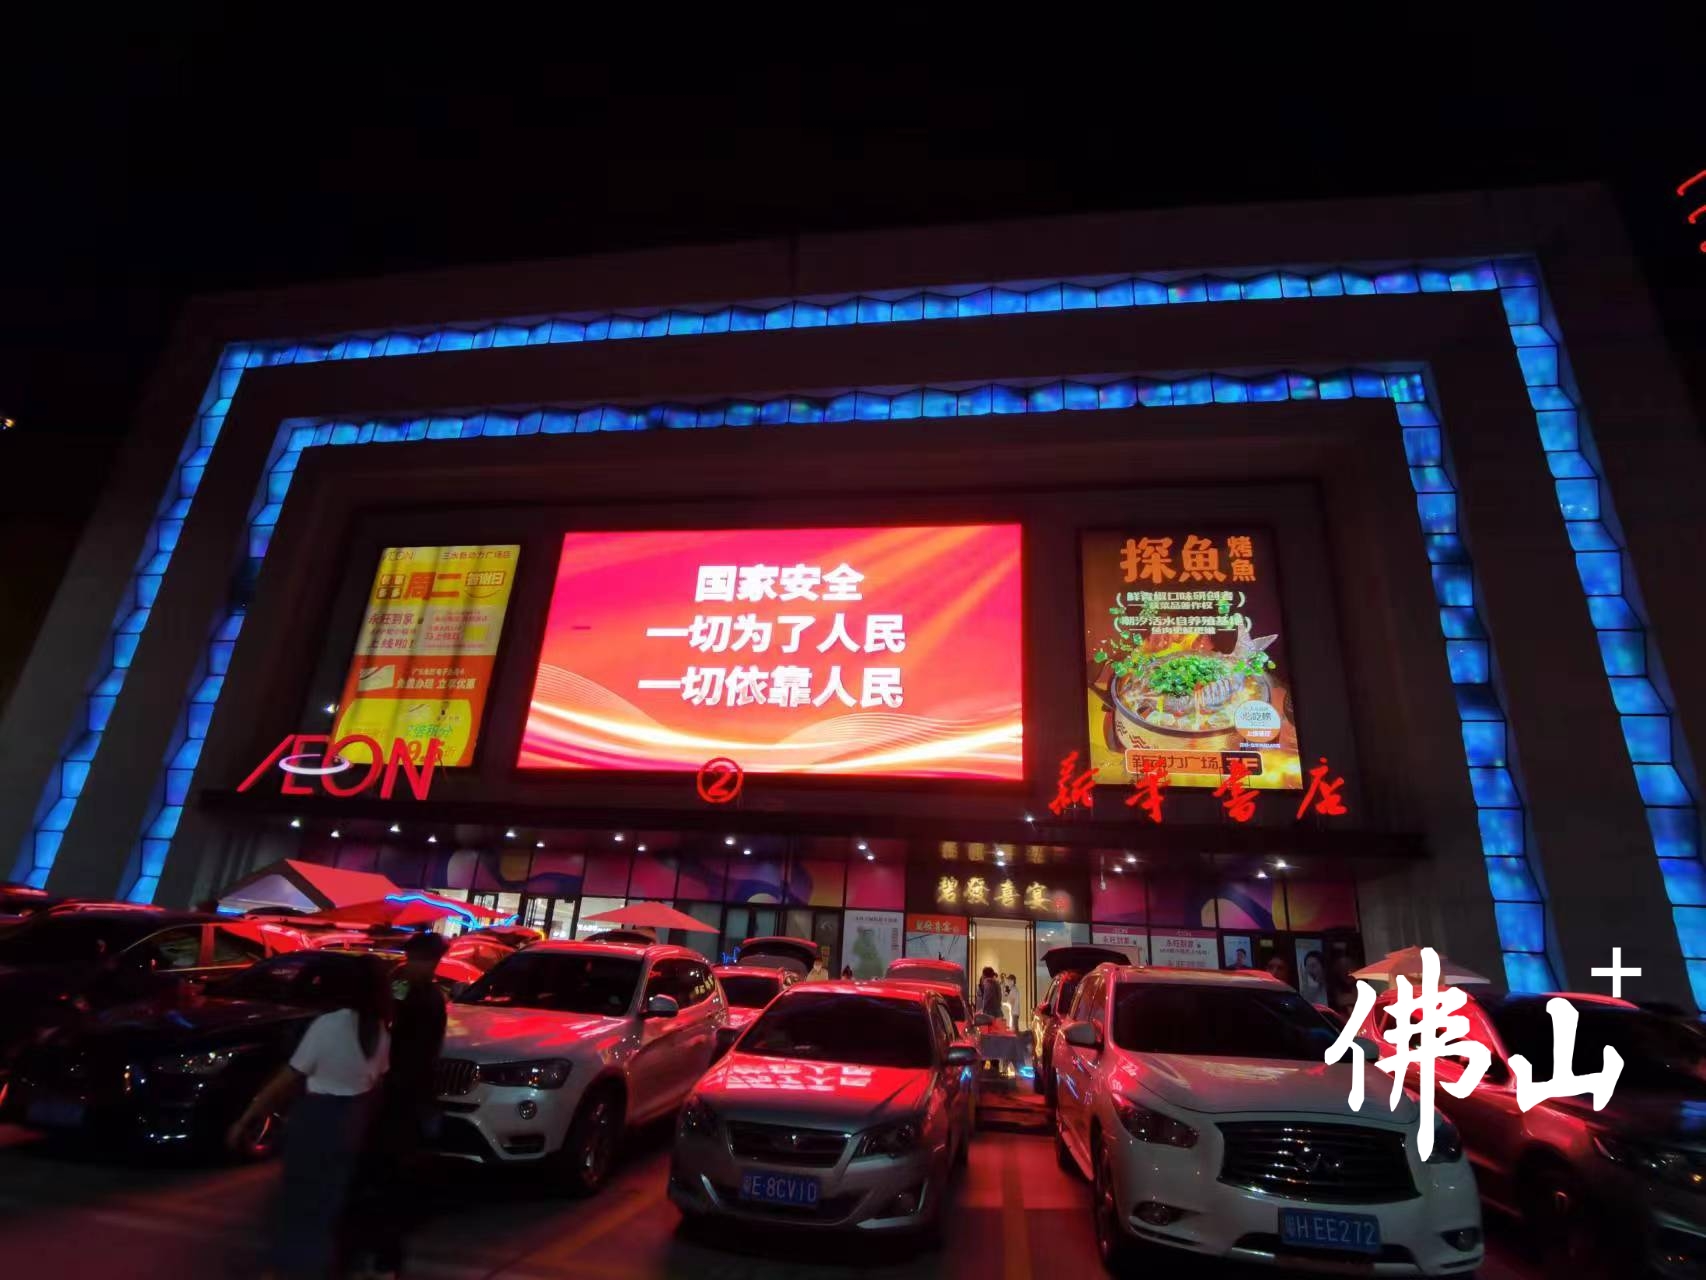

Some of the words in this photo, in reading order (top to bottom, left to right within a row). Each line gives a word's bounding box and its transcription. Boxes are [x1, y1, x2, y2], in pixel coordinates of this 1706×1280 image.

[1119, 533, 1227, 584] 探魚
[403, 571, 462, 600] 周二
[694, 562, 866, 603] 国家安全
[646, 613, 907, 654] 一切为了人民
[638, 664, 904, 708] 一切依靠人民
